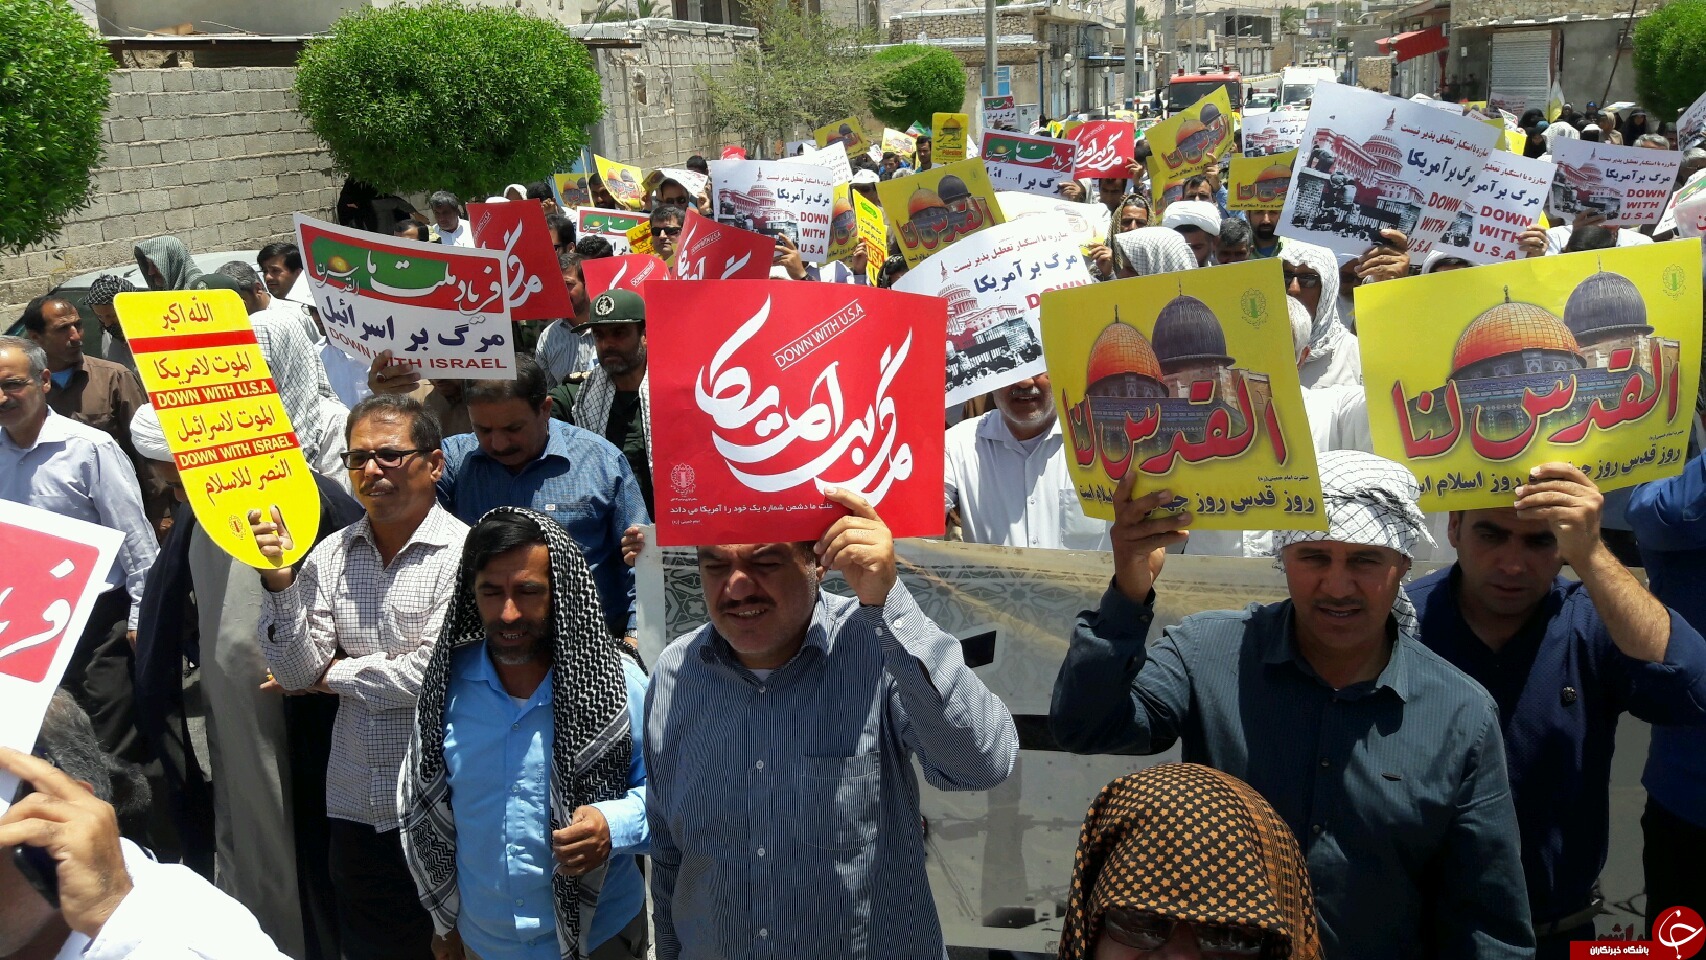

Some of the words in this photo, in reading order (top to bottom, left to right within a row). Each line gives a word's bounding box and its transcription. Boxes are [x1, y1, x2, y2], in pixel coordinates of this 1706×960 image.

[777, 188, 805, 204] آمریکا
[1428, 192, 1462, 212] DOWN
[1626, 188, 1666, 198] DOWN
[800, 212, 828, 224] DOWN
[1420, 216, 1448, 234] WITH
[1480, 206, 1532, 227] DOWN
[1620, 212, 1654, 220] U.S.A
[802, 228, 826, 239] WITH
[1480, 224, 1521, 244] WITH
[801, 244, 824, 254] U.S.A
[1473, 242, 1516, 260] U.S.A
[953, 261, 972, 274] نیست
[1030, 261, 1042, 280] بر
[1044, 252, 1078, 270] مرگ
[974, 260, 1022, 294] آمریکا
[405, 327, 430, 352] بر
[438, 324, 505, 352] مرگ
[774, 337, 814, 368] DOWN
[812, 320, 840, 344] WITH
[840, 303, 864, 326] U.S.A
[328, 326, 372, 360] DOWN
[373, 350, 422, 368] ITH
[430, 358, 507, 368] ISRAEL
[156, 392, 201, 408] DOWN
[202, 384, 236, 400] WITH
[237, 382, 272, 396] U.S.A
[1470, 342, 1680, 462] القدس
[1062, 388, 1097, 468] لنا
[1101, 376, 1288, 484] القدس
[1391, 380, 1464, 460] لنا
[179, 452, 218, 468] DOWN
[220, 444, 250, 460] WITH
[252, 436, 294, 453] ISRAEL
[1622, 444, 1656, 474] قدس
[1657, 446, 1680, 465] روز
[1594, 460, 1618, 480] روز
[1436, 471, 1483, 496] اسلام
[762, 504, 784, 512] شماره
[786, 503, 808, 512] دشمن
[1196, 493, 1226, 512] روز
[1231, 485, 1276, 512] قدس
[1284, 490, 1316, 512] روز
[670, 506, 687, 514] داند
[700, 504, 722, 514] آمریکا
[734, 505, 746, 514] خود
